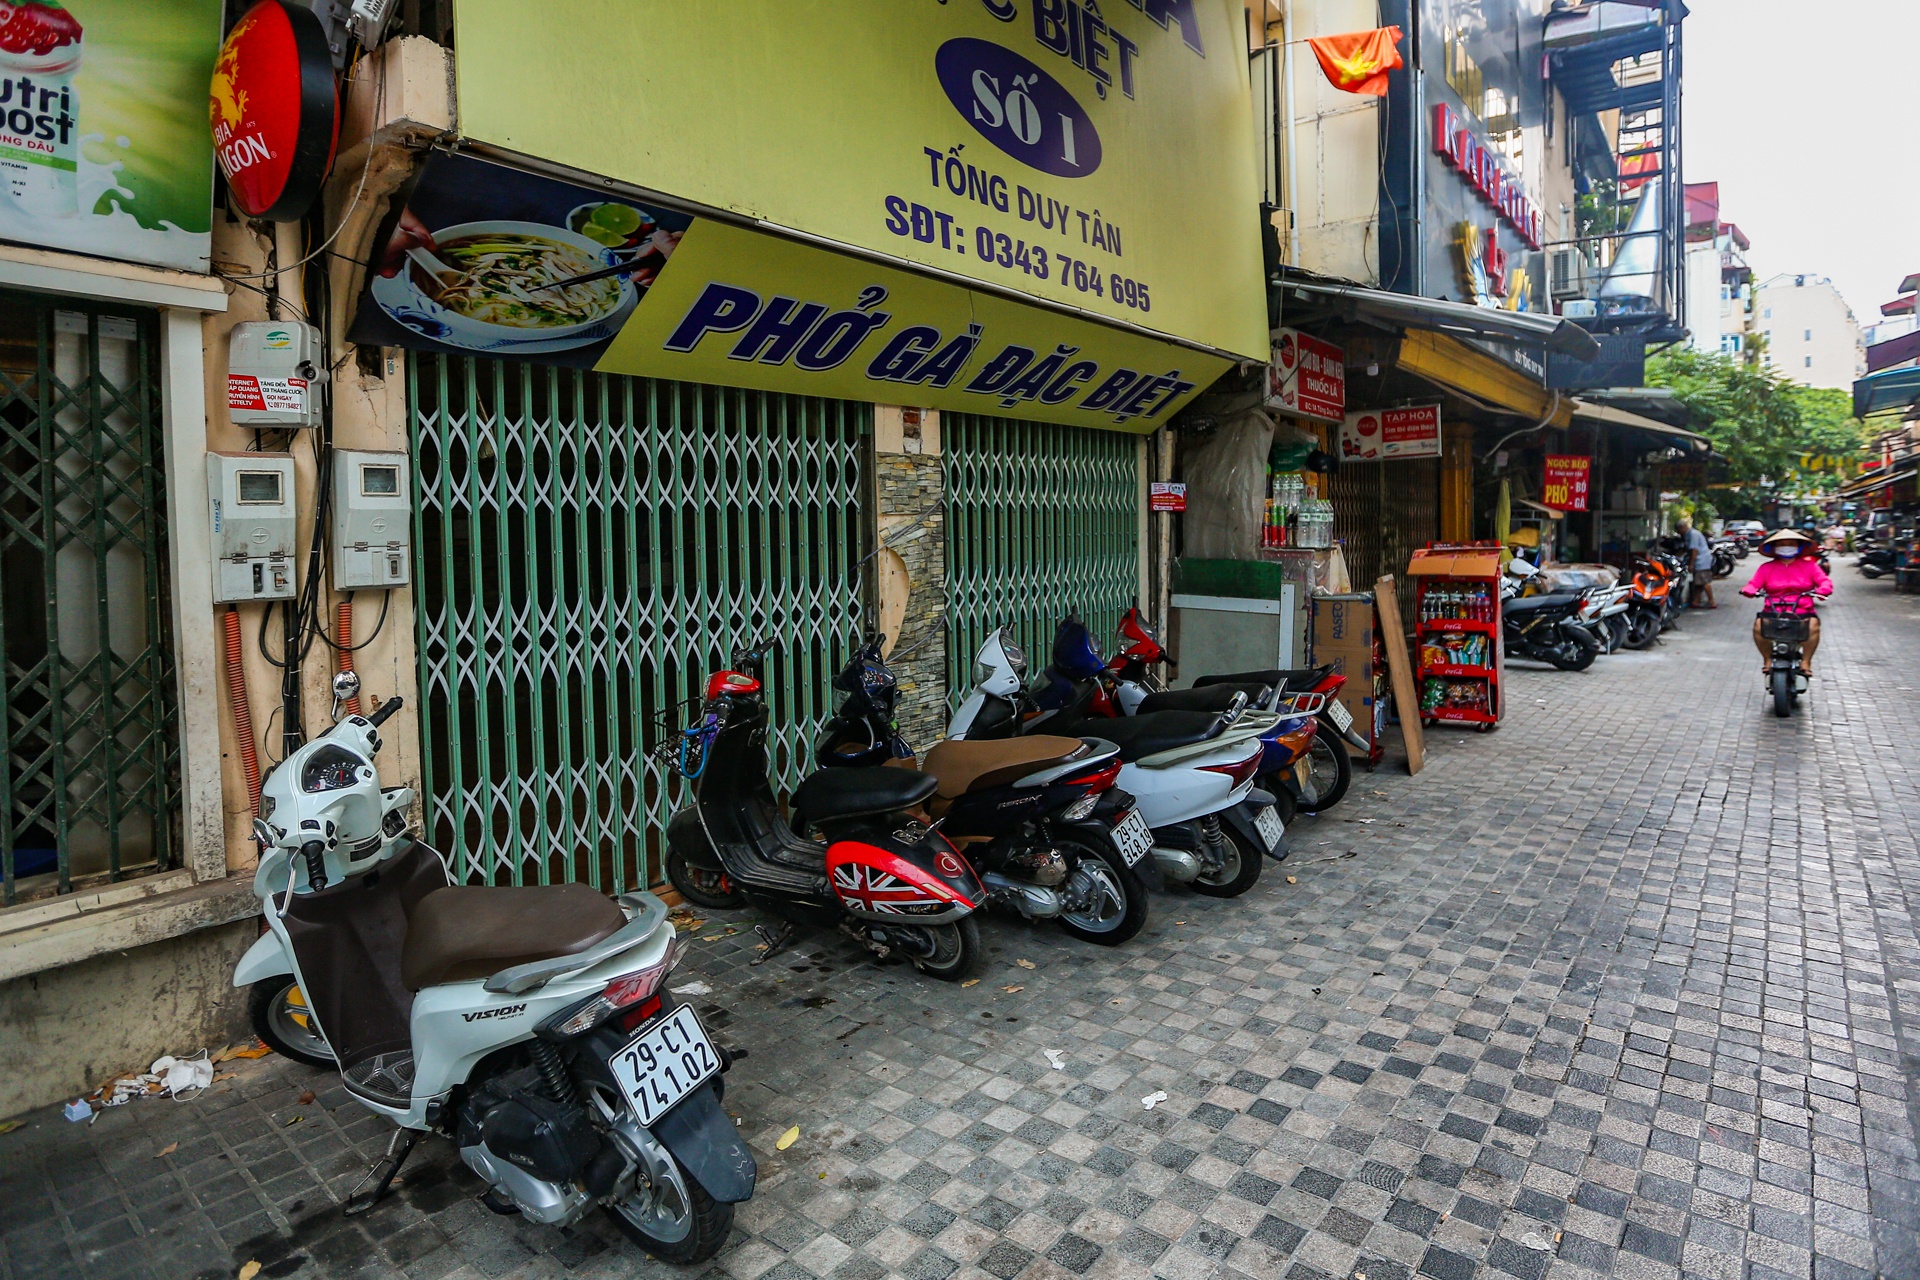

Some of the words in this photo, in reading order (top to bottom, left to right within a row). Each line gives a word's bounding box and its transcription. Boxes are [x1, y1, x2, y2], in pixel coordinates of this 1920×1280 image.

[972, 69, 1042, 145] SỐ
[1058, 112, 1080, 167] 1
[27, 141, 55, 153] DÂU
[215, 121, 232, 146] BIA
[1, 161, 28, 170] VITAMIN
[924, 144, 1009, 213] TỐNG
[1017, 185, 1070, 236] DUY
[1077, 210, 1122, 257] TÂN
[885, 195, 965, 254] SĐT:
[976, 226, 1049, 280] 0343
[1056, 253, 1104, 298] 764
[1110, 274, 1151, 312] 695
[663, 282, 892, 371] PHỞ
[865, 323, 985, 388] GÀ
[963, 344, 1099, 409] ĐẶC
[1079, 368, 1196, 424] BIỆT
[1307, 377, 1329, 394] THUỐC
[1330, 383, 1338, 398] LÁ
[1547, 458, 1570, 469] NGỌC
[1545, 477, 1569, 504] PHỞ
[1574, 495, 1585, 508] GÀ
[1332, 601, 1344, 640] PASEO
[1117, 814, 1143, 845] 29-C1
[1123, 828, 1153, 864] 348.19
[461, 1003, 528, 1022] VISION
[629, 1016, 656, 1037] HONDA
[625, 1016, 691, 1083] 29-C1
[634, 1042, 715, 1120] 741.02
